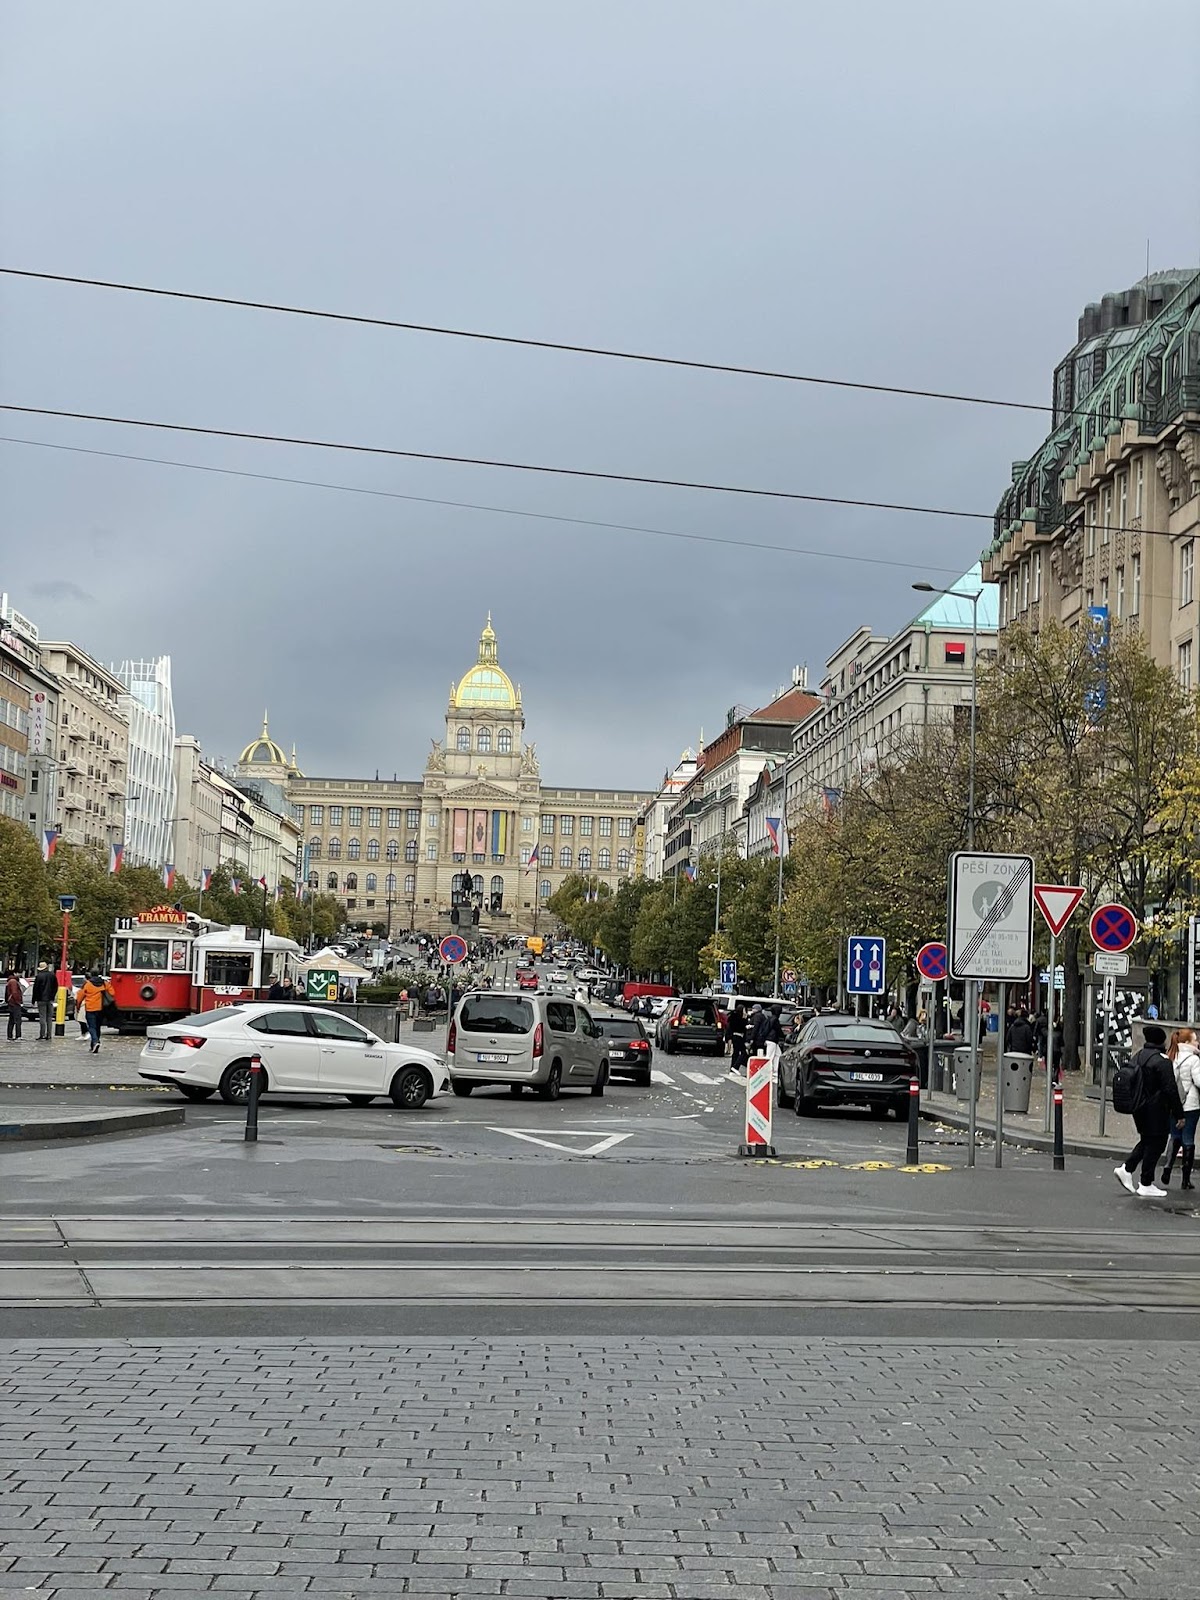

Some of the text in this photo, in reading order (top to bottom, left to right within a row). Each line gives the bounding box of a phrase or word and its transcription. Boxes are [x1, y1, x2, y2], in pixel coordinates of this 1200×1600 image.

[34, 706, 42, 754] RAMADA
[962, 861, 1017, 875] PĚŠÍ ZÓN
[121, 918, 130, 929] 11
[139, 912, 187, 924] TRAMVAJ
[135, 974, 164, 983] 2077
[329, 974, 337, 983] A
[329, 988, 336, 997] B
